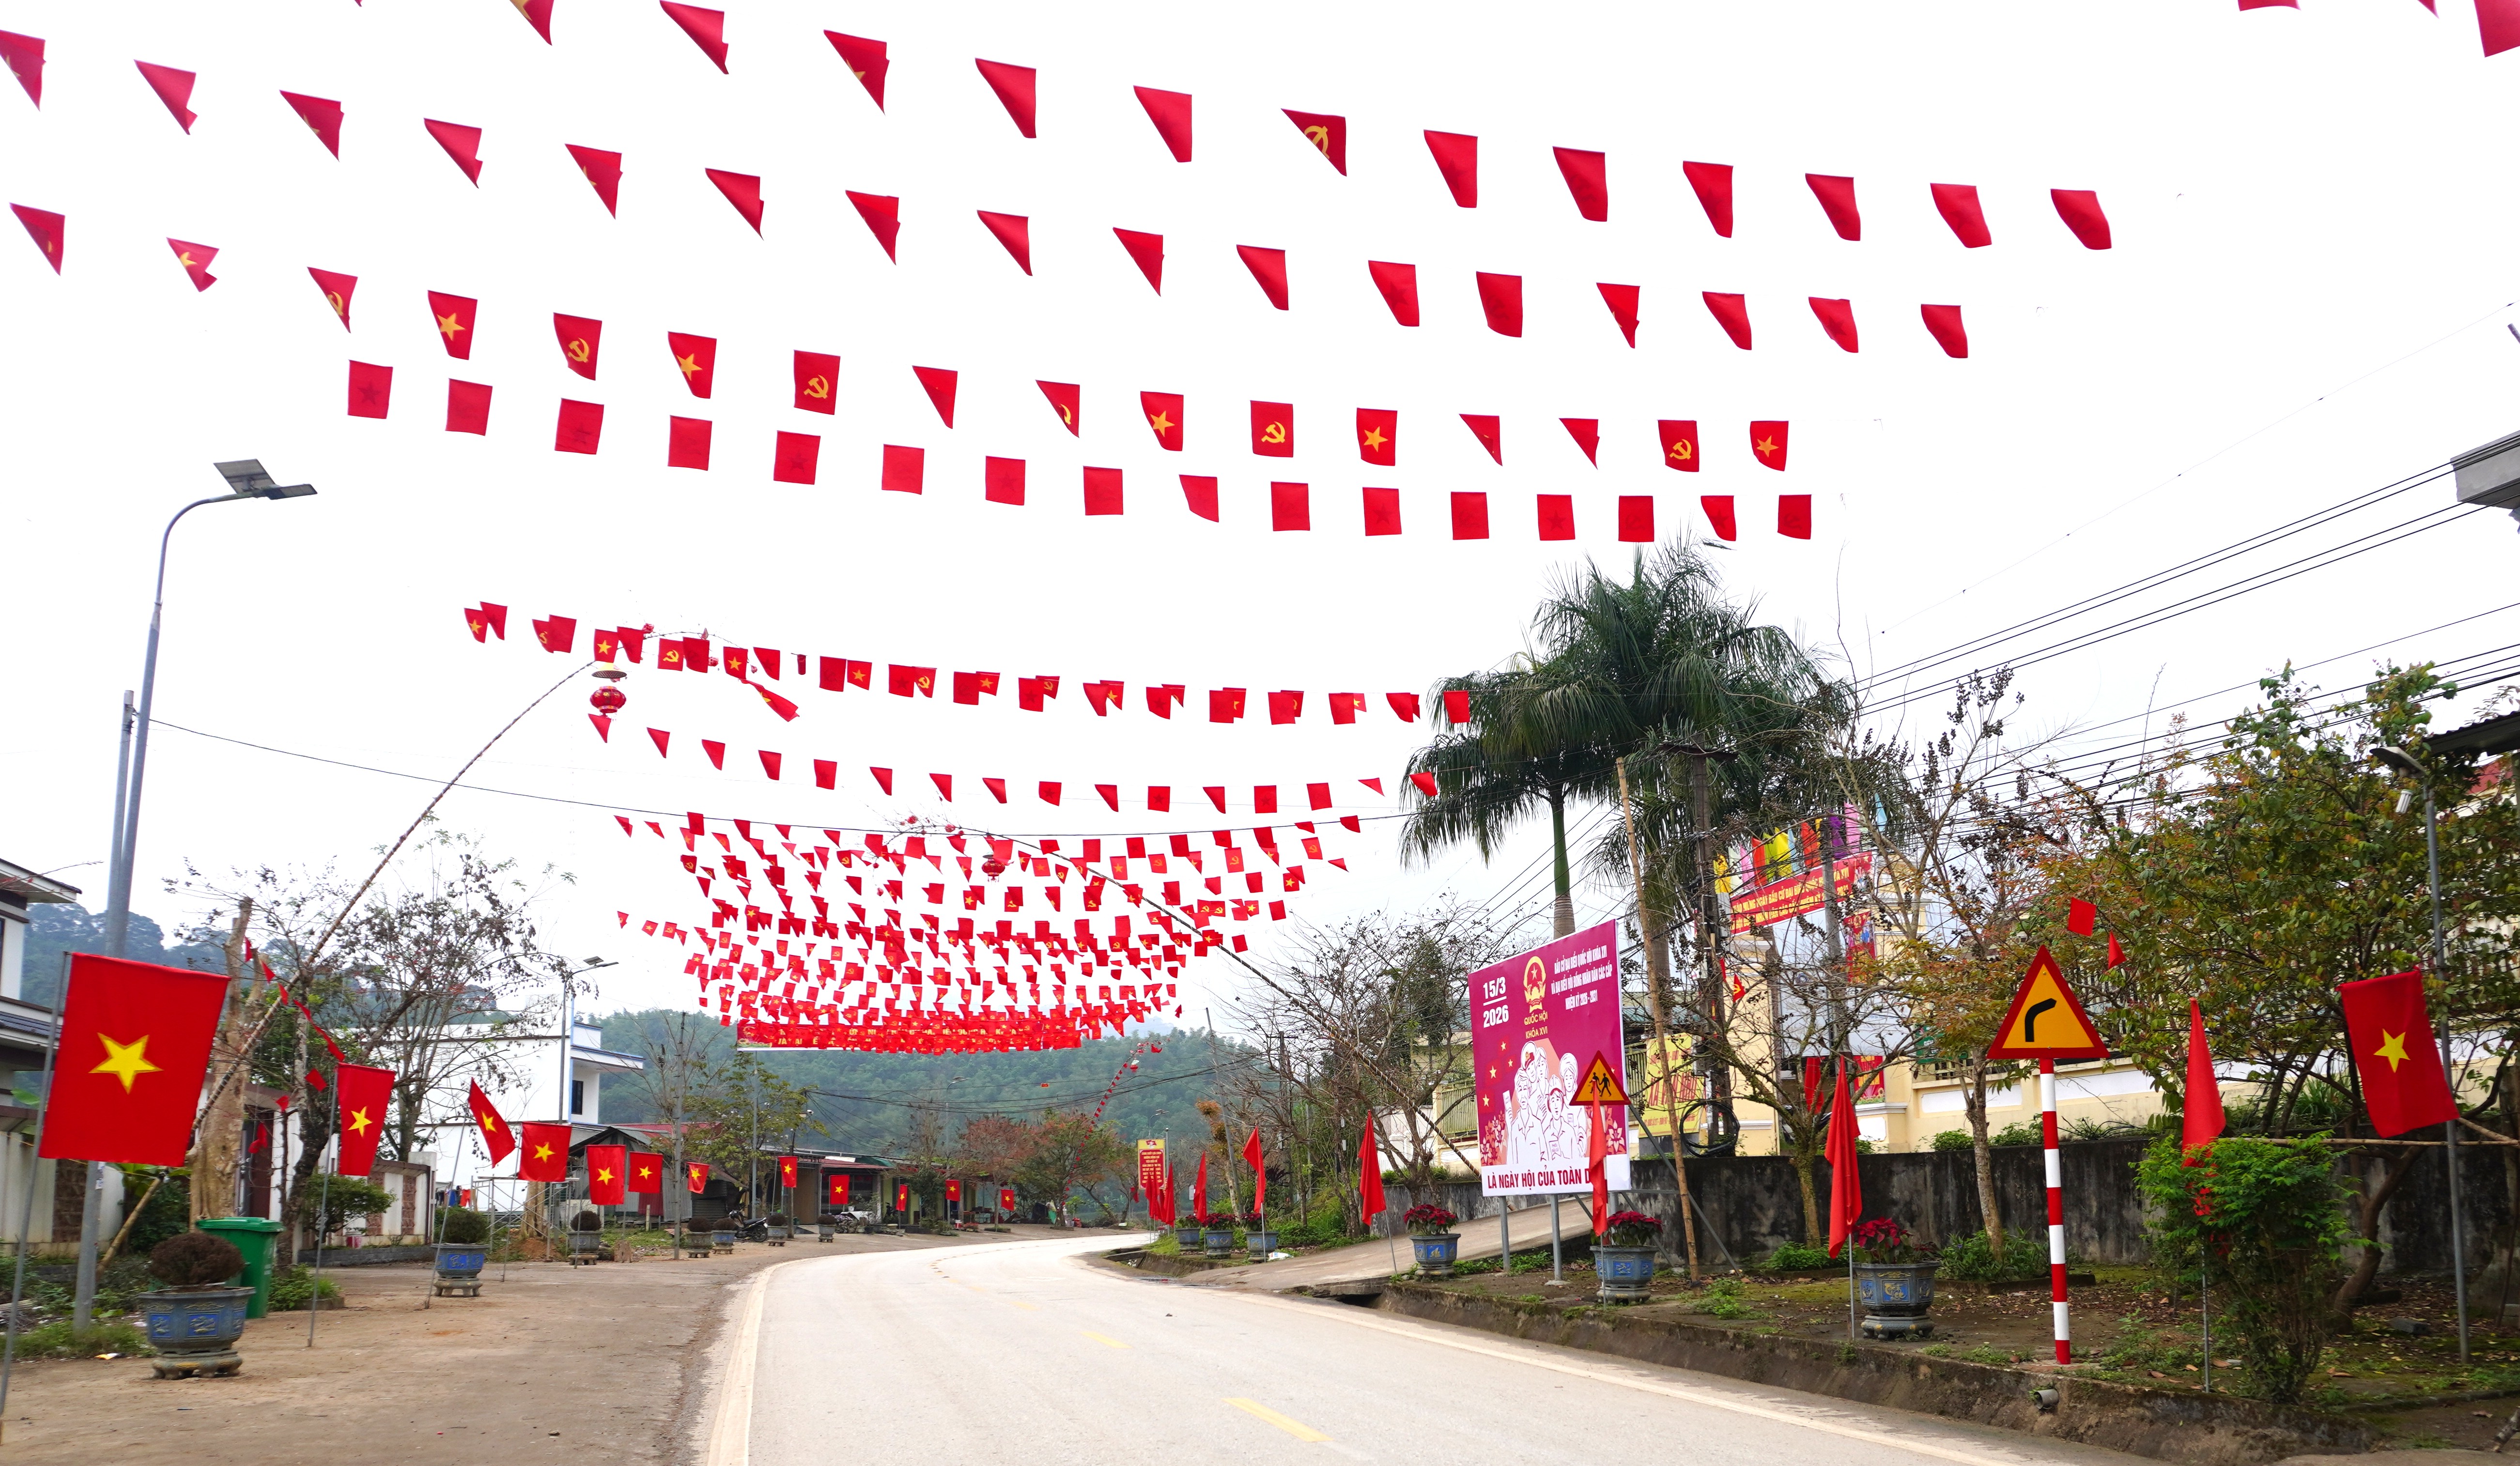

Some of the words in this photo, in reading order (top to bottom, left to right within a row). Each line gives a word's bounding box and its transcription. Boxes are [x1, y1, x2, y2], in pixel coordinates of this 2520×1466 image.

[1483, 976, 1506, 999] 15/3
[1483, 1004, 1509, 1028] 2026
[1524, 1012, 1538, 1025] QUỐC
[1539, 1010, 1548, 1022] HỘI
[1525, 1027, 1539, 1039] KHÓA
[1539, 1026, 1548, 1036] XVI
[1487, 1172, 1497, 1189] LÀ
[1499, 1171, 1519, 1188] NGÀY
[1521, 1169, 1535, 1190] HỘI
[1537, 1165, 1556, 1187] CỦA
[1557, 1166, 1582, 1186] TOÀN
